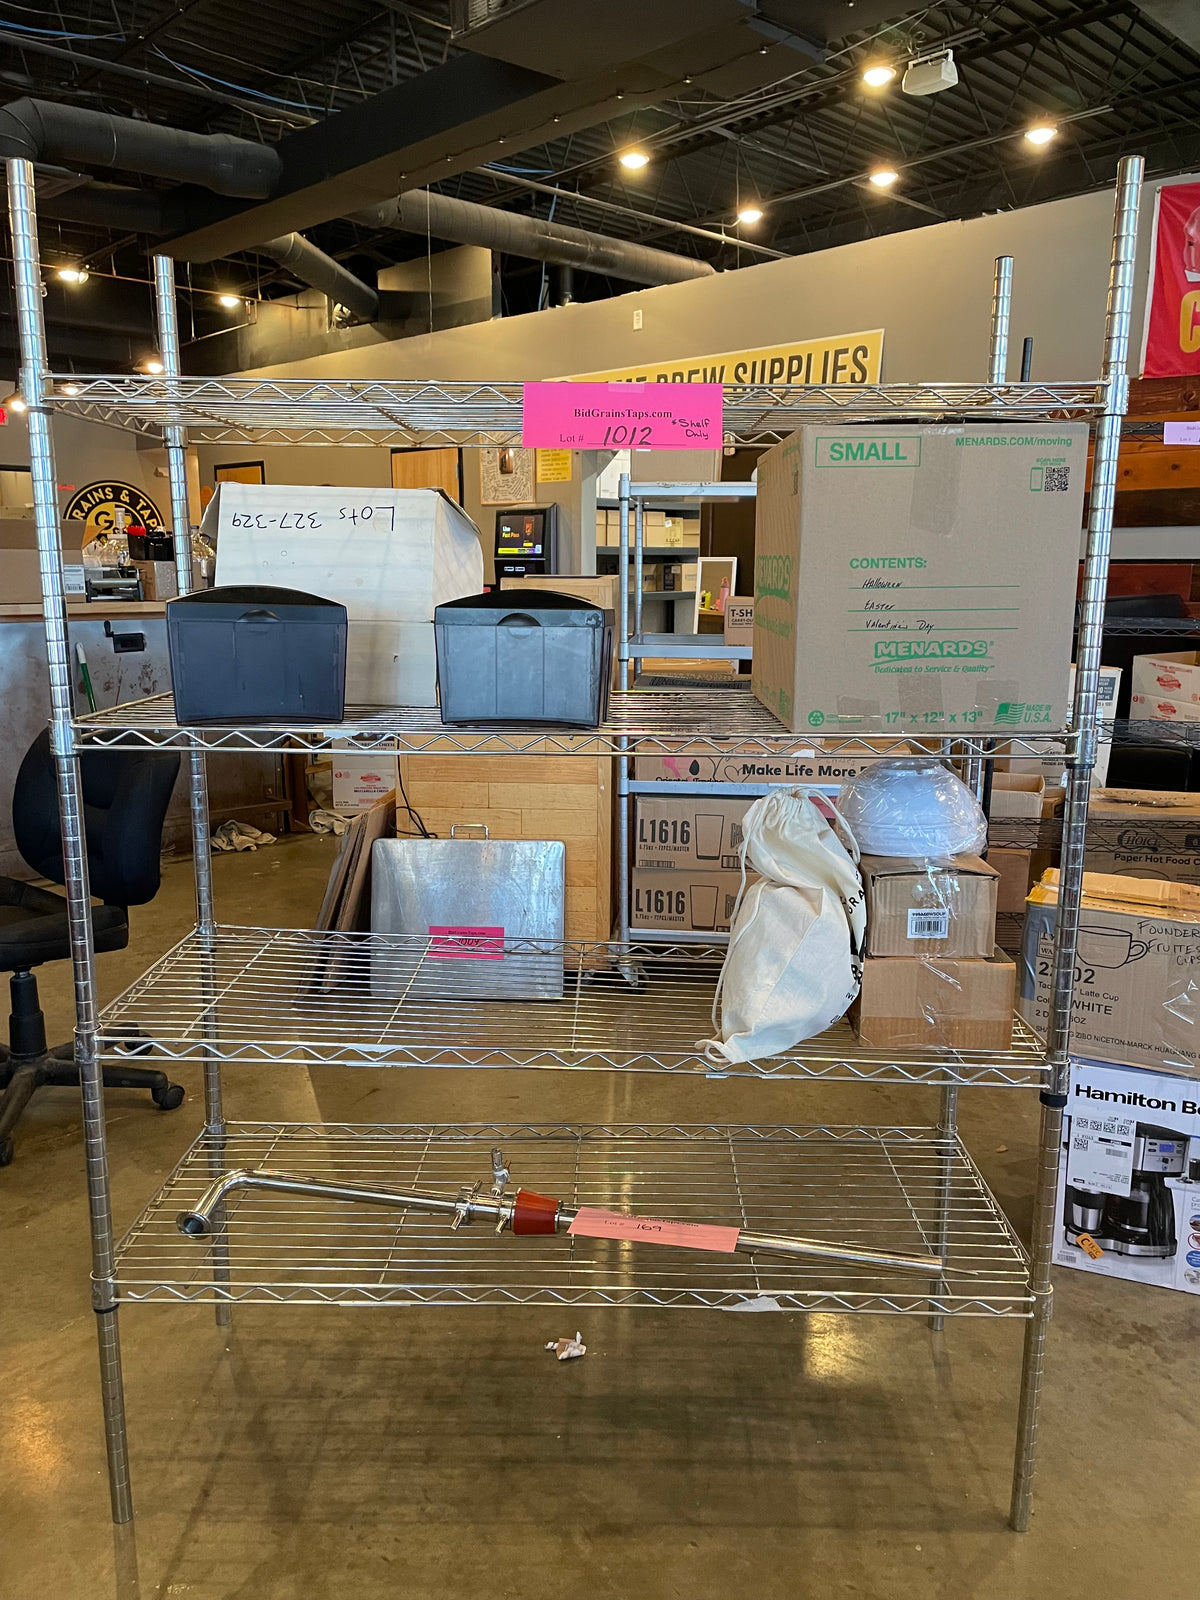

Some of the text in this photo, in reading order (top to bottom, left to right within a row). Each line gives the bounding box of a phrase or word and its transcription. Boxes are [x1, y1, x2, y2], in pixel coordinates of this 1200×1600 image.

[574, 409, 673, 419] BidGrainsTaps.com
[559, 425, 653, 446] Lot # 1012
[685, 429, 709, 440] Only
[955, 437, 1073, 447] MENARDS.COM/moving
[829, 442, 908, 461] SMALL
[72, 487, 160, 530] RAINS & TAP
[232, 505, 395, 531] Lots 327-329
[850, 557, 928, 569] CONTENTS:
[874, 640, 989, 659] MENARDS
[874, 665, 912, 674] Dedicated
[914, 665, 923, 673] to
[925, 665, 952, 673] Service
[884, 711, 906, 724] 17"
[923, 711, 945, 724] 12"
[961, 711, 984, 723] 13"
[1023, 712, 1053, 723] U.S.A.
[742, 763, 782, 777] Make
[785, 764, 814, 777] Life
[818, 765, 856, 777] More
[639, 818, 691, 845] L1616
[1114, 853, 1143, 863] Paper
[1145, 855, 1164, 864] Hot
[1165, 856, 1191, 866] Food
[635, 888, 686, 915] L1616
[1080, 989, 1100, 999] Latte
[1102, 992, 1120, 1002] Cup
[1071, 999, 1113, 1015] WHITE
[1075, 1083, 1177, 1112] Hamilton
[636, 1224, 662, 1232] 169
